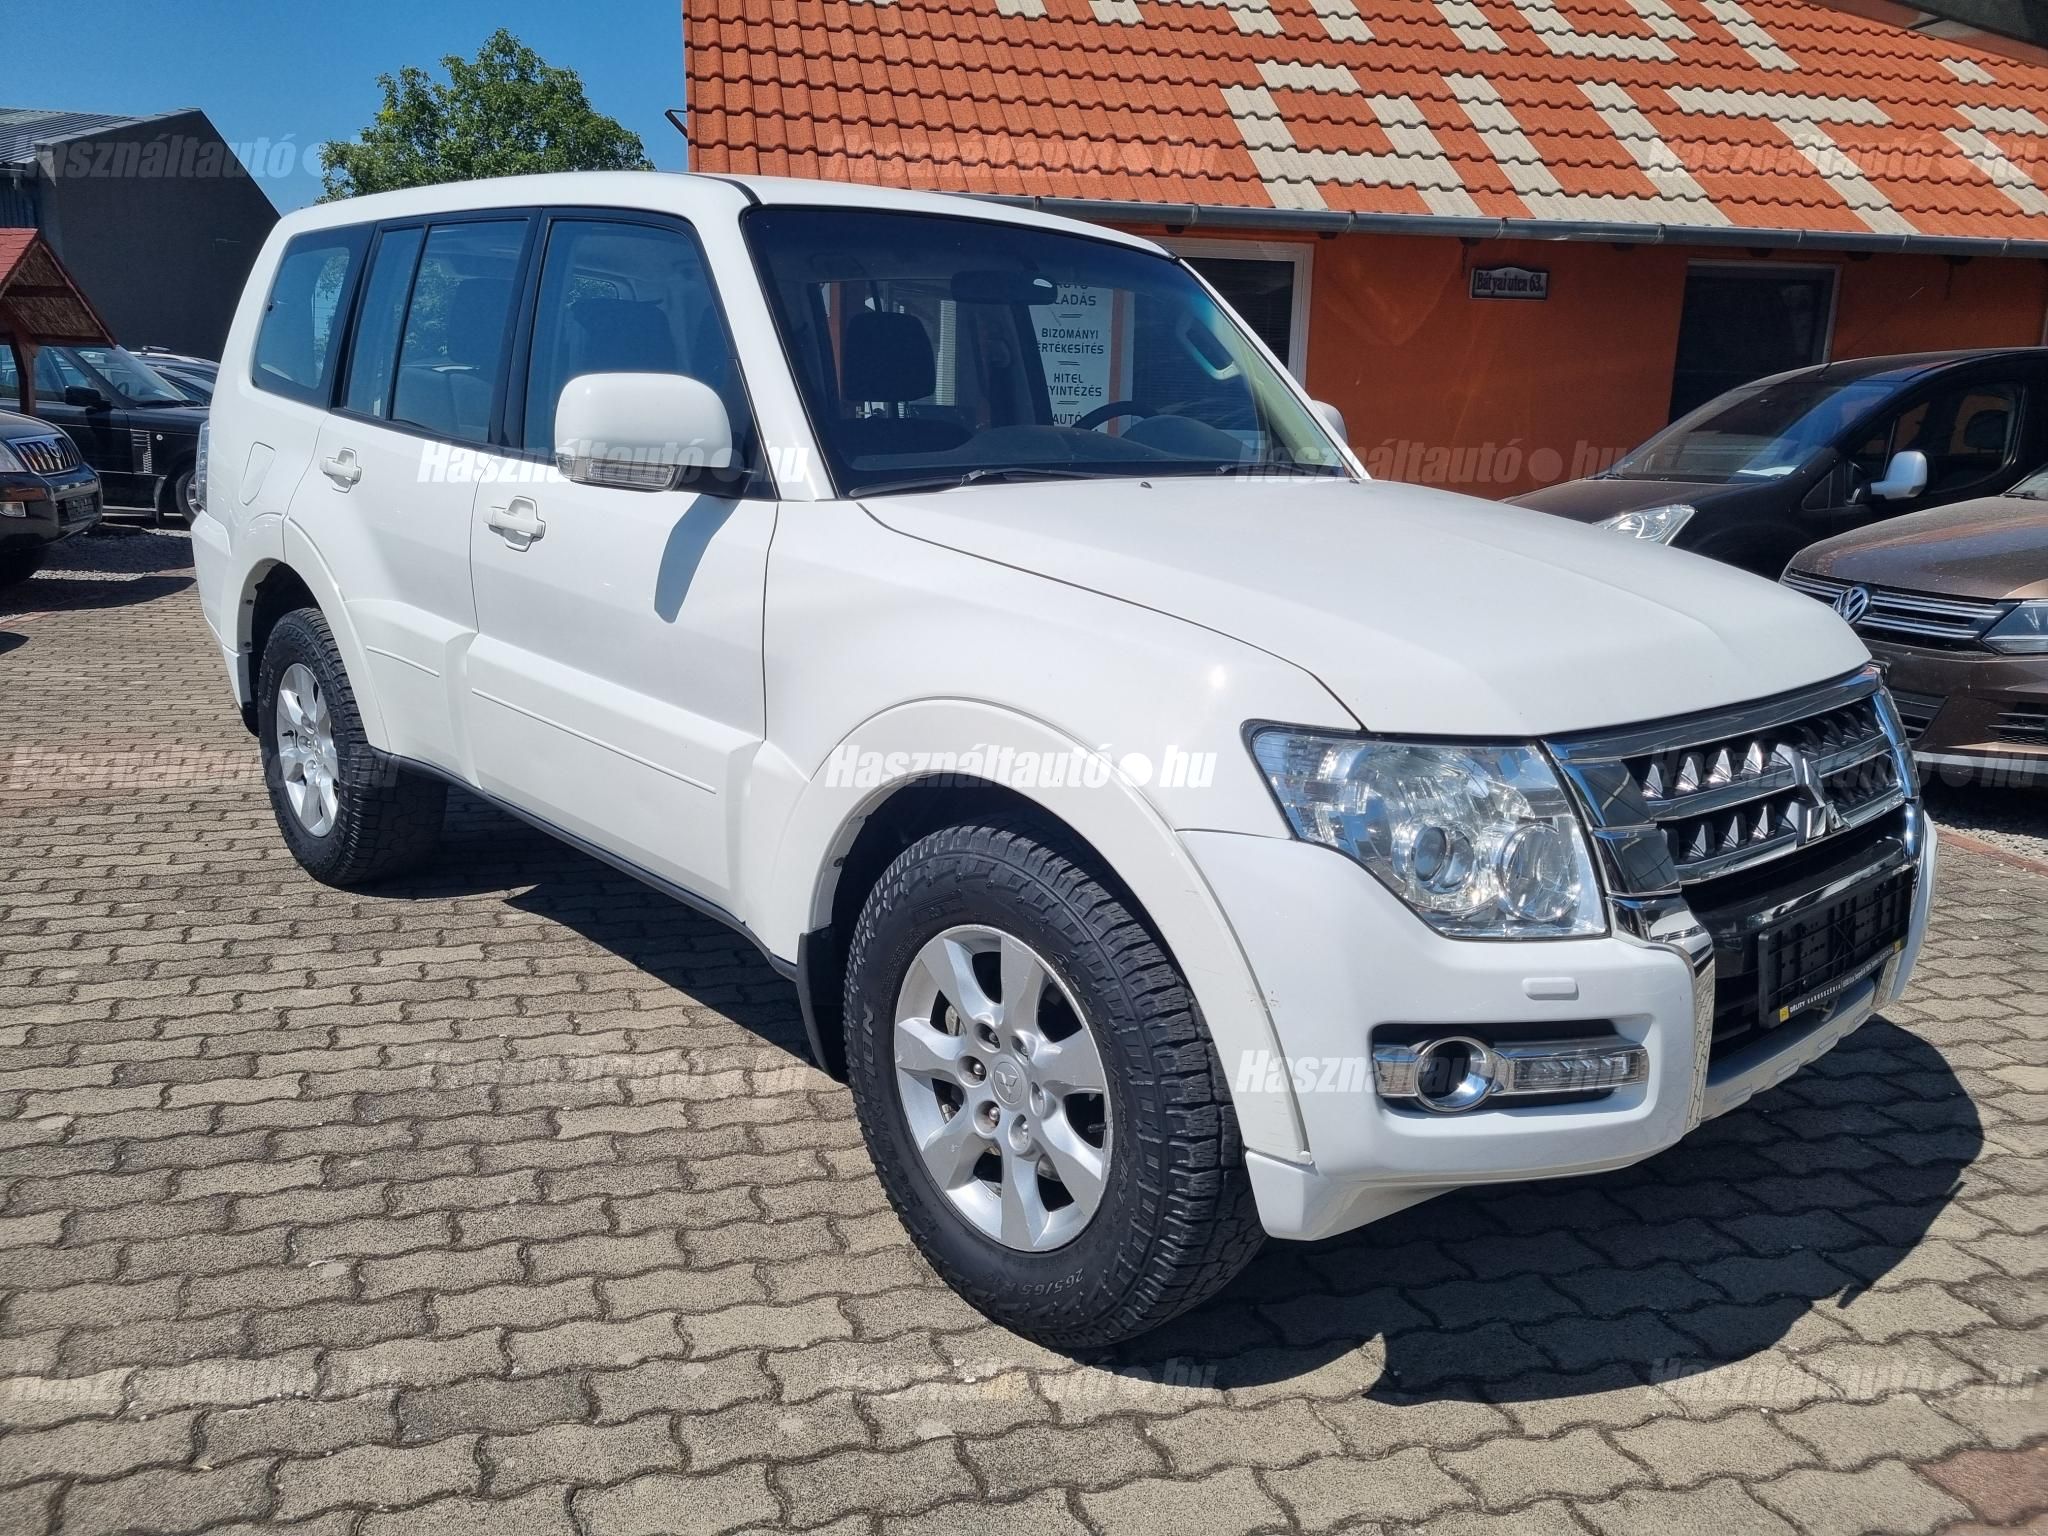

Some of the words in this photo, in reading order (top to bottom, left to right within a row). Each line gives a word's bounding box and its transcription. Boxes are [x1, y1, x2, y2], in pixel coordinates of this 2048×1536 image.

[1041, 327, 1099, 340] BIZOMÁNYI
[1053, 373, 1084, 384] HITEL
[1048, 384, 1103, 397] YINTÉZÉS
